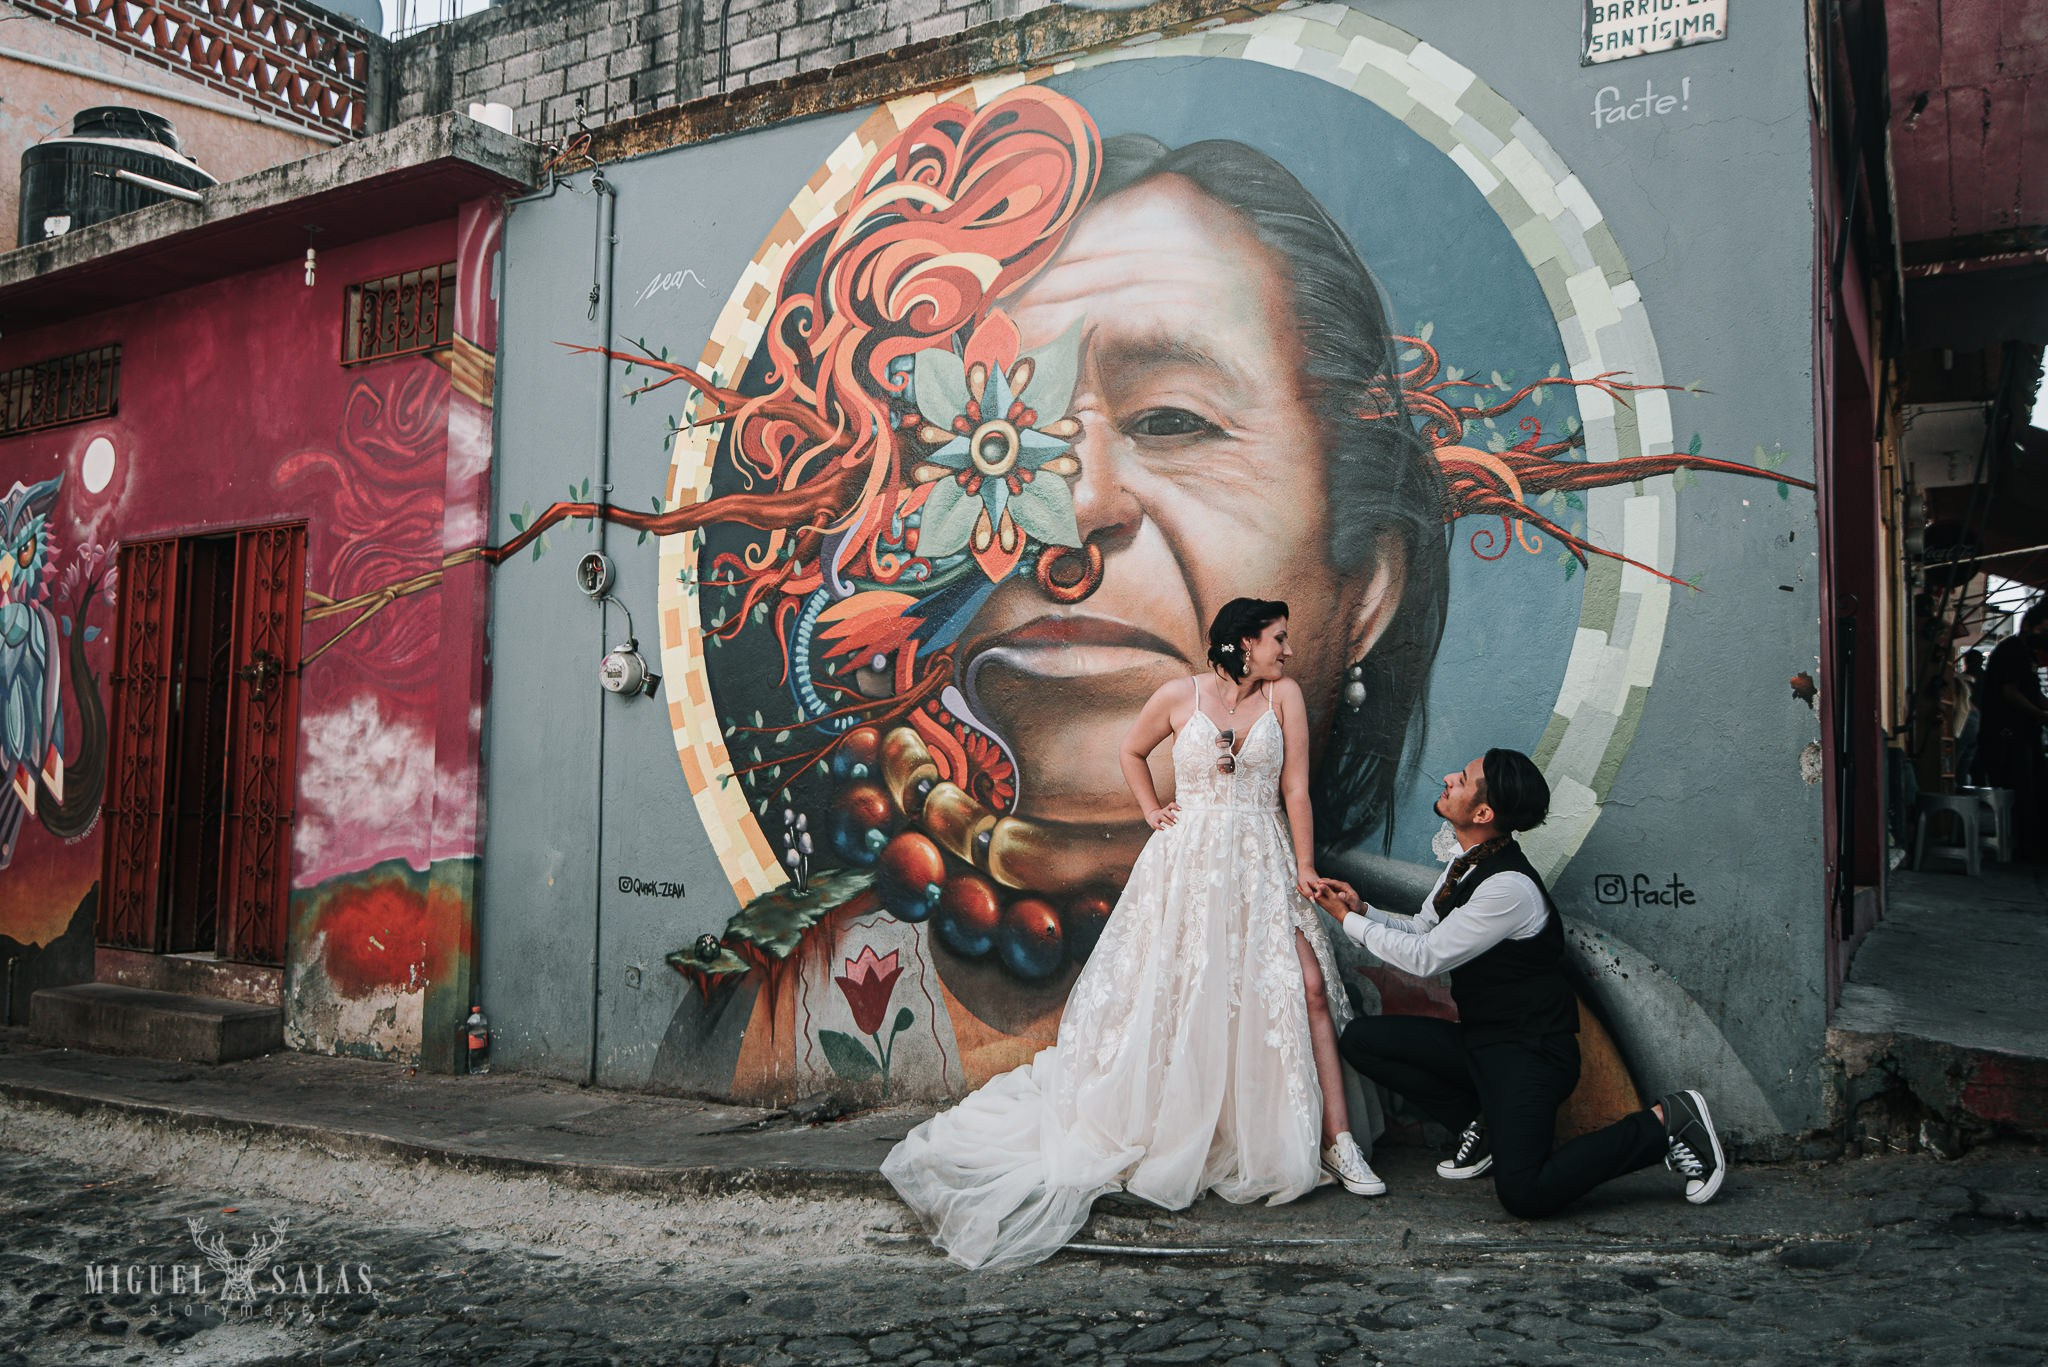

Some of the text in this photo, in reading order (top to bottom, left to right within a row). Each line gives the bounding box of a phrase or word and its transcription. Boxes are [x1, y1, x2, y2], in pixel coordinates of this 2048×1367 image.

[1592, 13, 1715, 52] SANTÍSIMA
[1590, 76, 1690, 129] facte!
[1630, 872, 1696, 908] facte
